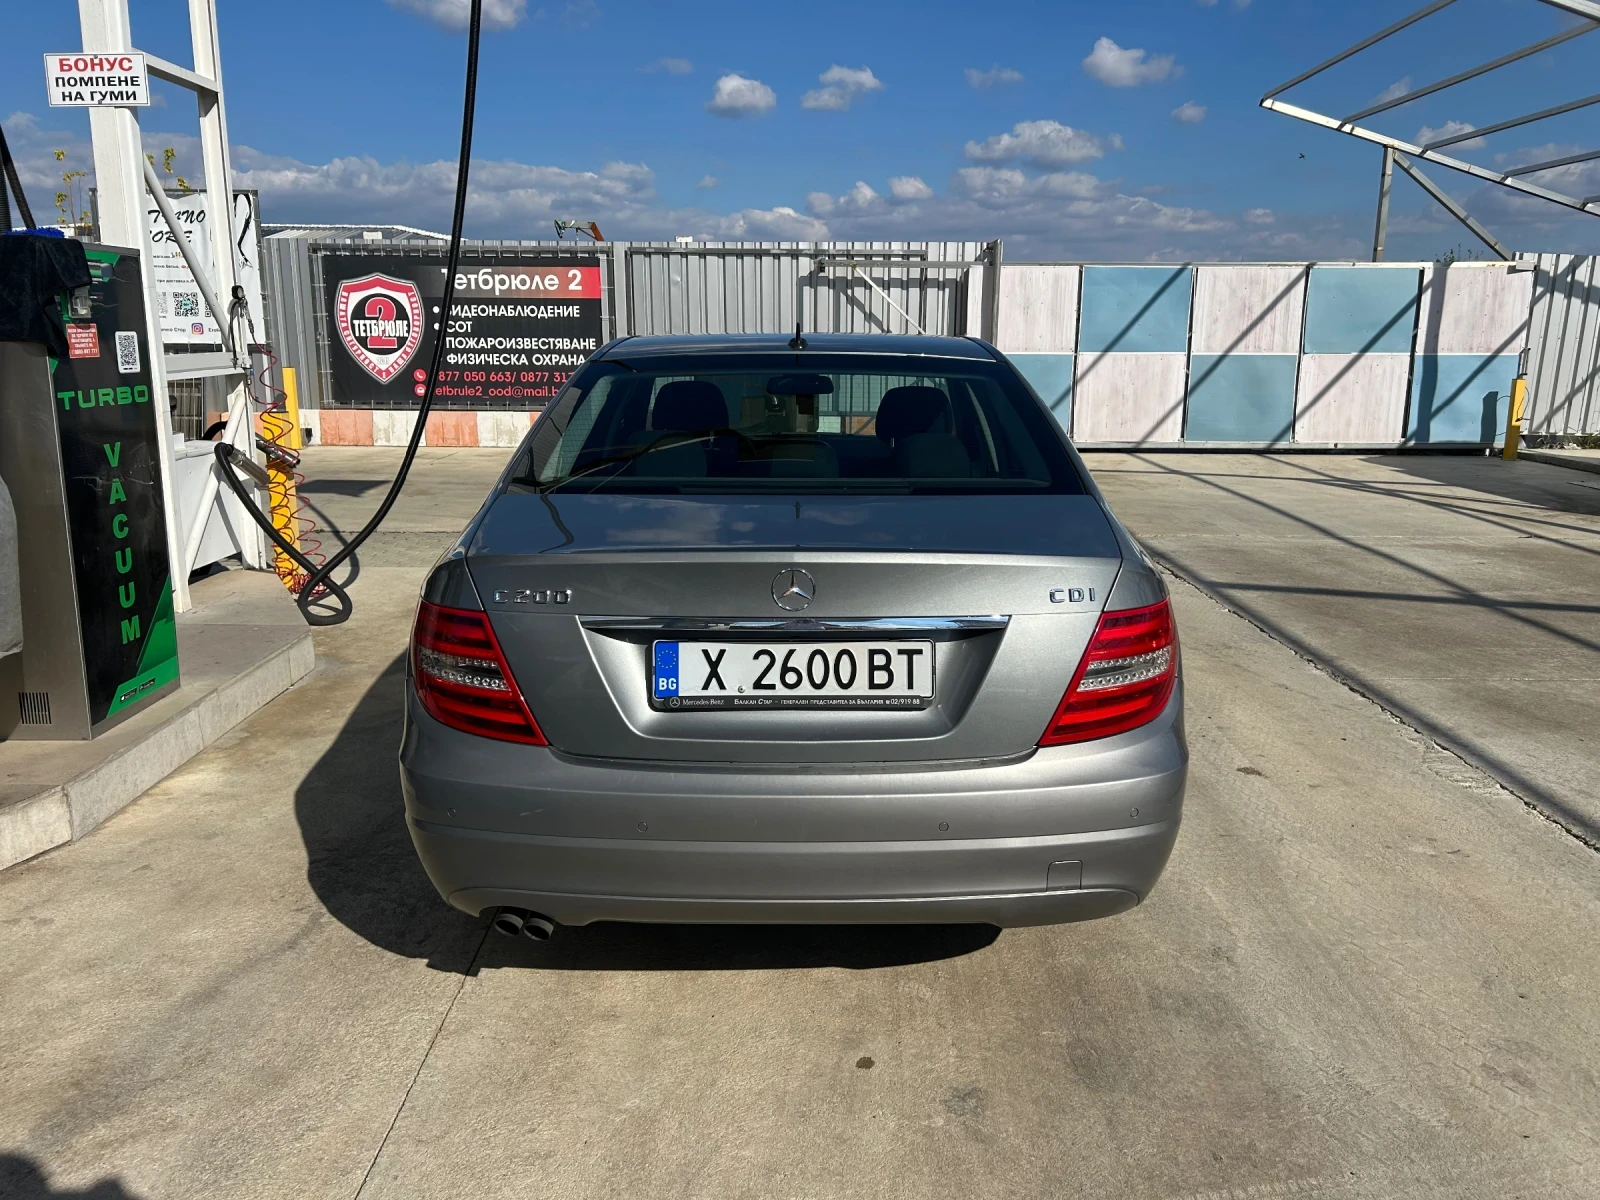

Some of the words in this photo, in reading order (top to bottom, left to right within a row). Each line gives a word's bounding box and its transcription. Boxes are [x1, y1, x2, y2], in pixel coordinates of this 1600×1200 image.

[58, 57, 133, 73] БОНУС
[55, 76, 141, 88] ПОМПЕНЕ
[61, 91, 85, 102] НА
[90, 90, 137, 102] ГУМИ
[567, 269, 583, 291] 2
[450, 304, 580, 318] ИДЕОНАБЛЮДЕНИЕ
[353, 320, 409, 337] ТЕТБРЮЛЕ
[446, 337, 596, 350] ПОЖАРОИЗВЕСТЯВАНЕ
[446, 353, 529, 366] ФИЗИЧЕСКА
[532, 353, 586, 366] ОХРАНА
[438, 371, 460, 382] 877
[463, 371, 486, 382] 050
[489, 371, 517, 383] 663/
[520, 371, 550, 383] 0877
[57, 385, 149, 410] TURBO
[435, 385, 560, 399] etbrule2_ood@mail.b
[104, 442, 141, 645] VACUUM
[493, 589, 509, 603] C
[513, 589, 572, 604] 200
[1049, 587, 1096, 603] CDI
[701, 648, 727, 690] X
[752, 648, 857, 690] 2600
[867, 648, 923, 690] BT
[658, 678, 677, 690] BG
